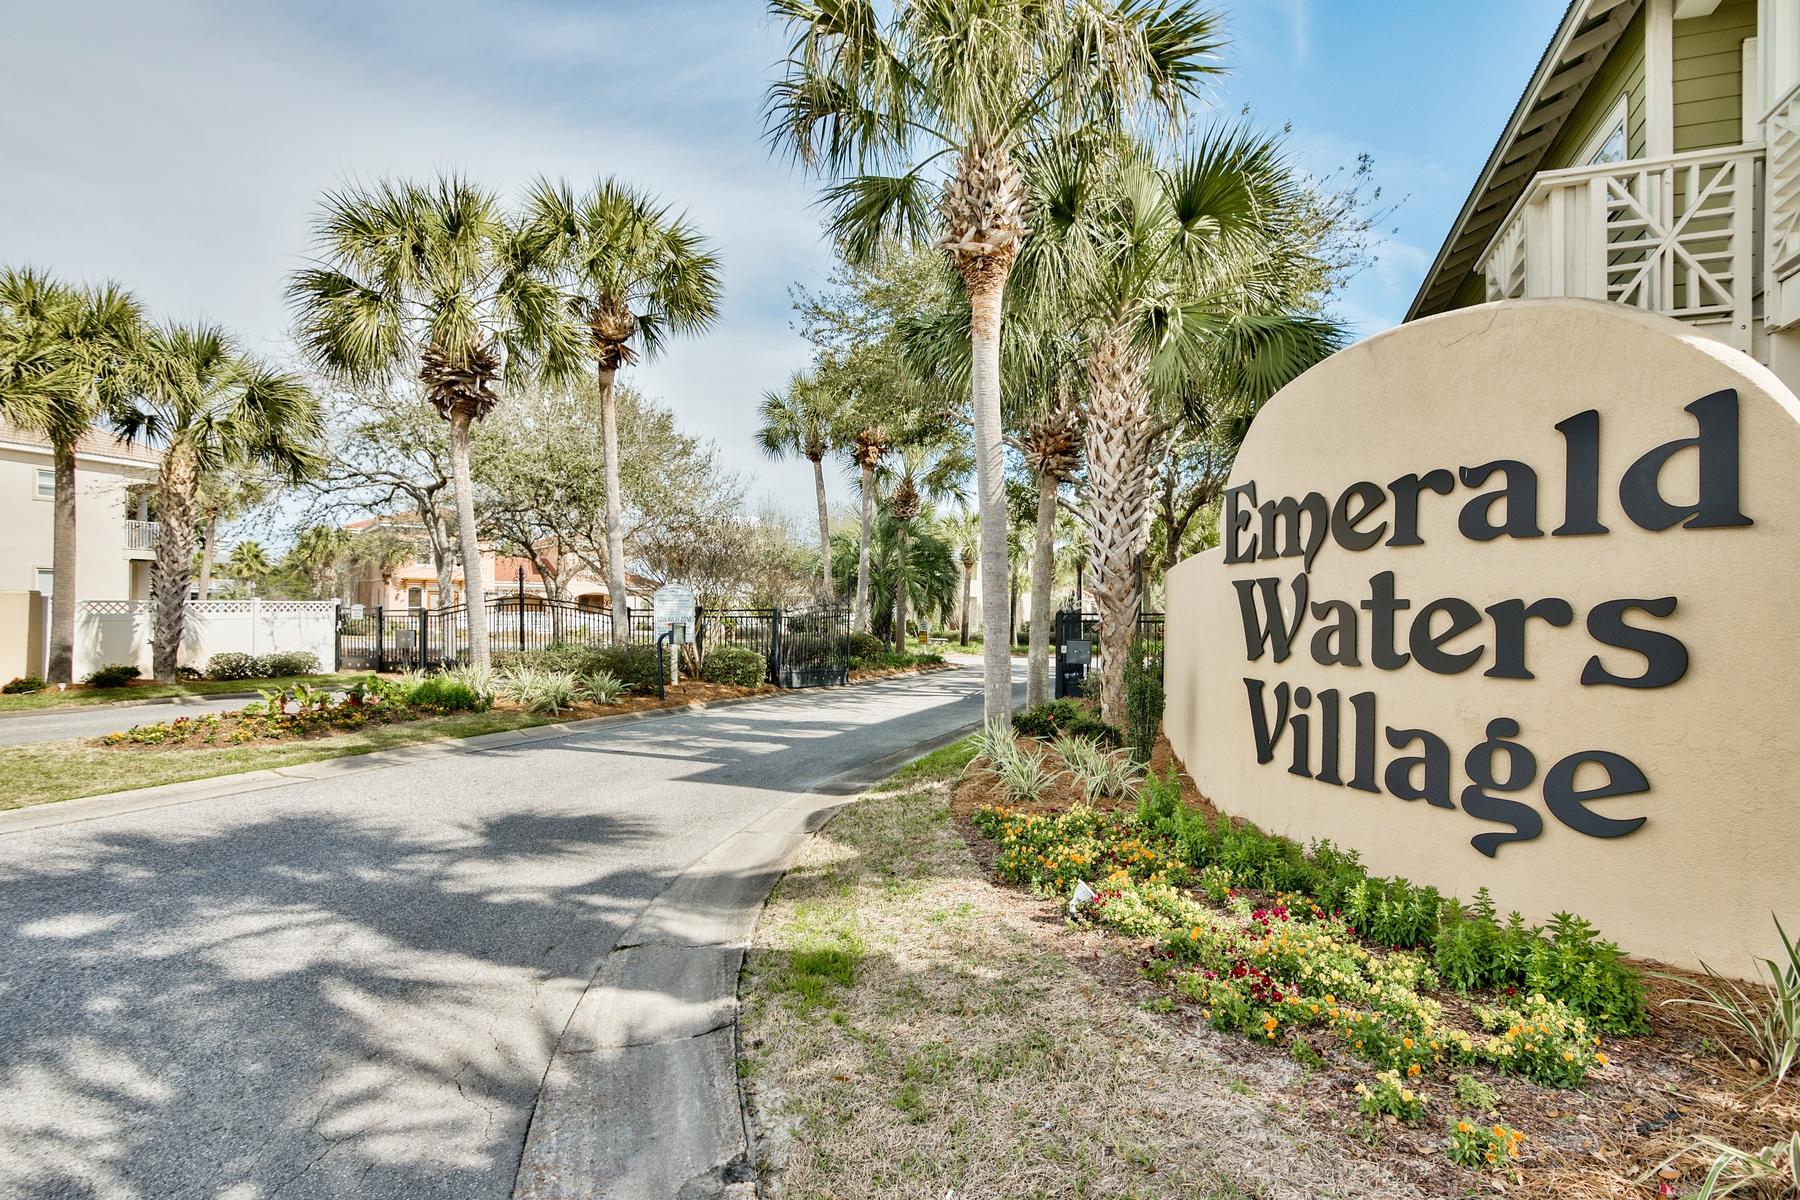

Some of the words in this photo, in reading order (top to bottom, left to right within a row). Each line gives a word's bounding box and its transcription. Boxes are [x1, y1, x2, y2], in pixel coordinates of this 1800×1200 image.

[1222, 388, 1755, 573] Emerald
[1232, 570, 1689, 690] Waters
[1243, 677, 1651, 858] Village
